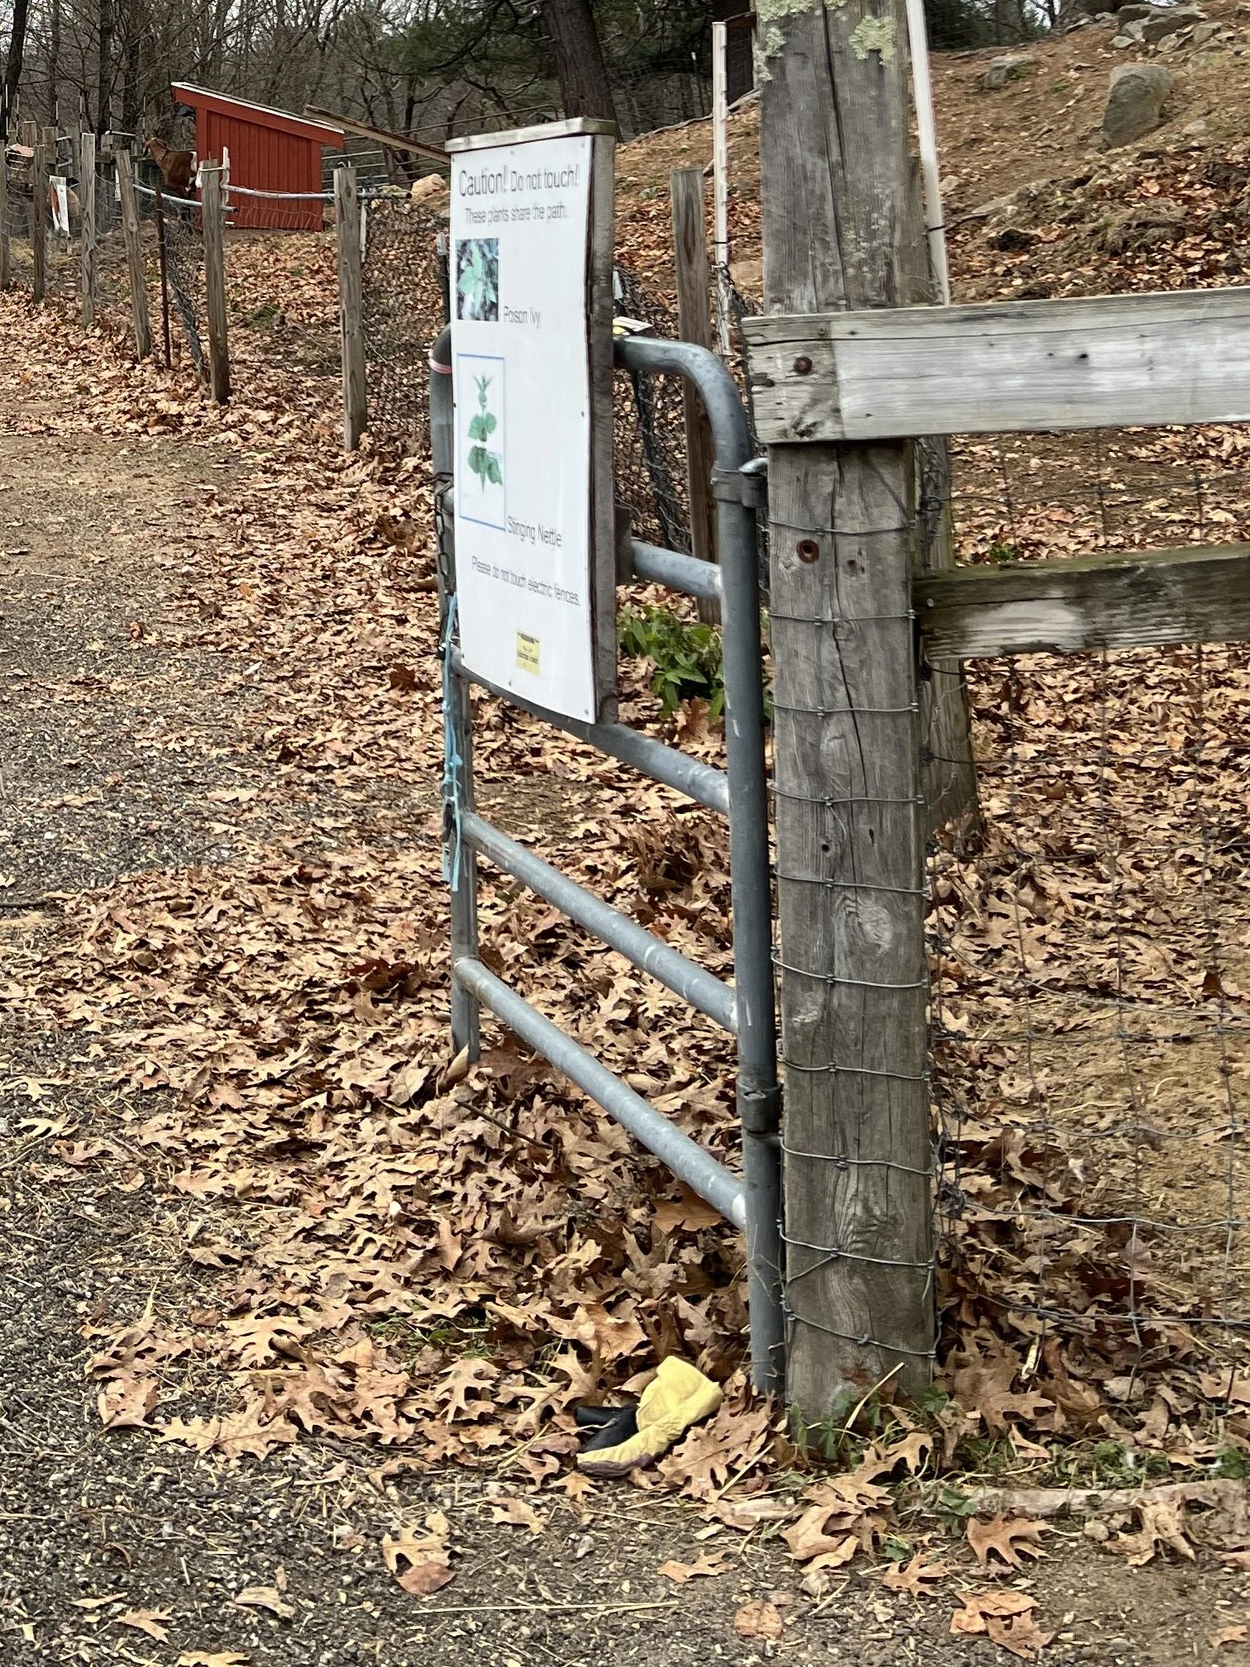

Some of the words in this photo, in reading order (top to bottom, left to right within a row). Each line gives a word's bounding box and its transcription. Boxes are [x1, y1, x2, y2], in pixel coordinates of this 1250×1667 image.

[459, 165, 507, 196] Caution!
[511, 171, 523, 192] Do
[526, 168, 541, 190] not
[544, 164, 579, 189] touch!
[465, 208, 486, 224] These
[488, 206, 509, 226] plants
[511, 204, 530, 222] share
[532, 203, 545, 221] the
[503, 305, 527, 323] Poison
[530, 306, 541, 329] Ivy
[507, 515, 535, 544] Stinging
[538, 524, 562, 547] Nettle
[471, 555, 491, 576] Please
[492, 564, 499, 579] do
[500, 567, 509, 583] not
[510, 570, 526, 588] touch
[528, 576, 552, 598] electric
[554, 583, 580, 606] fences.
